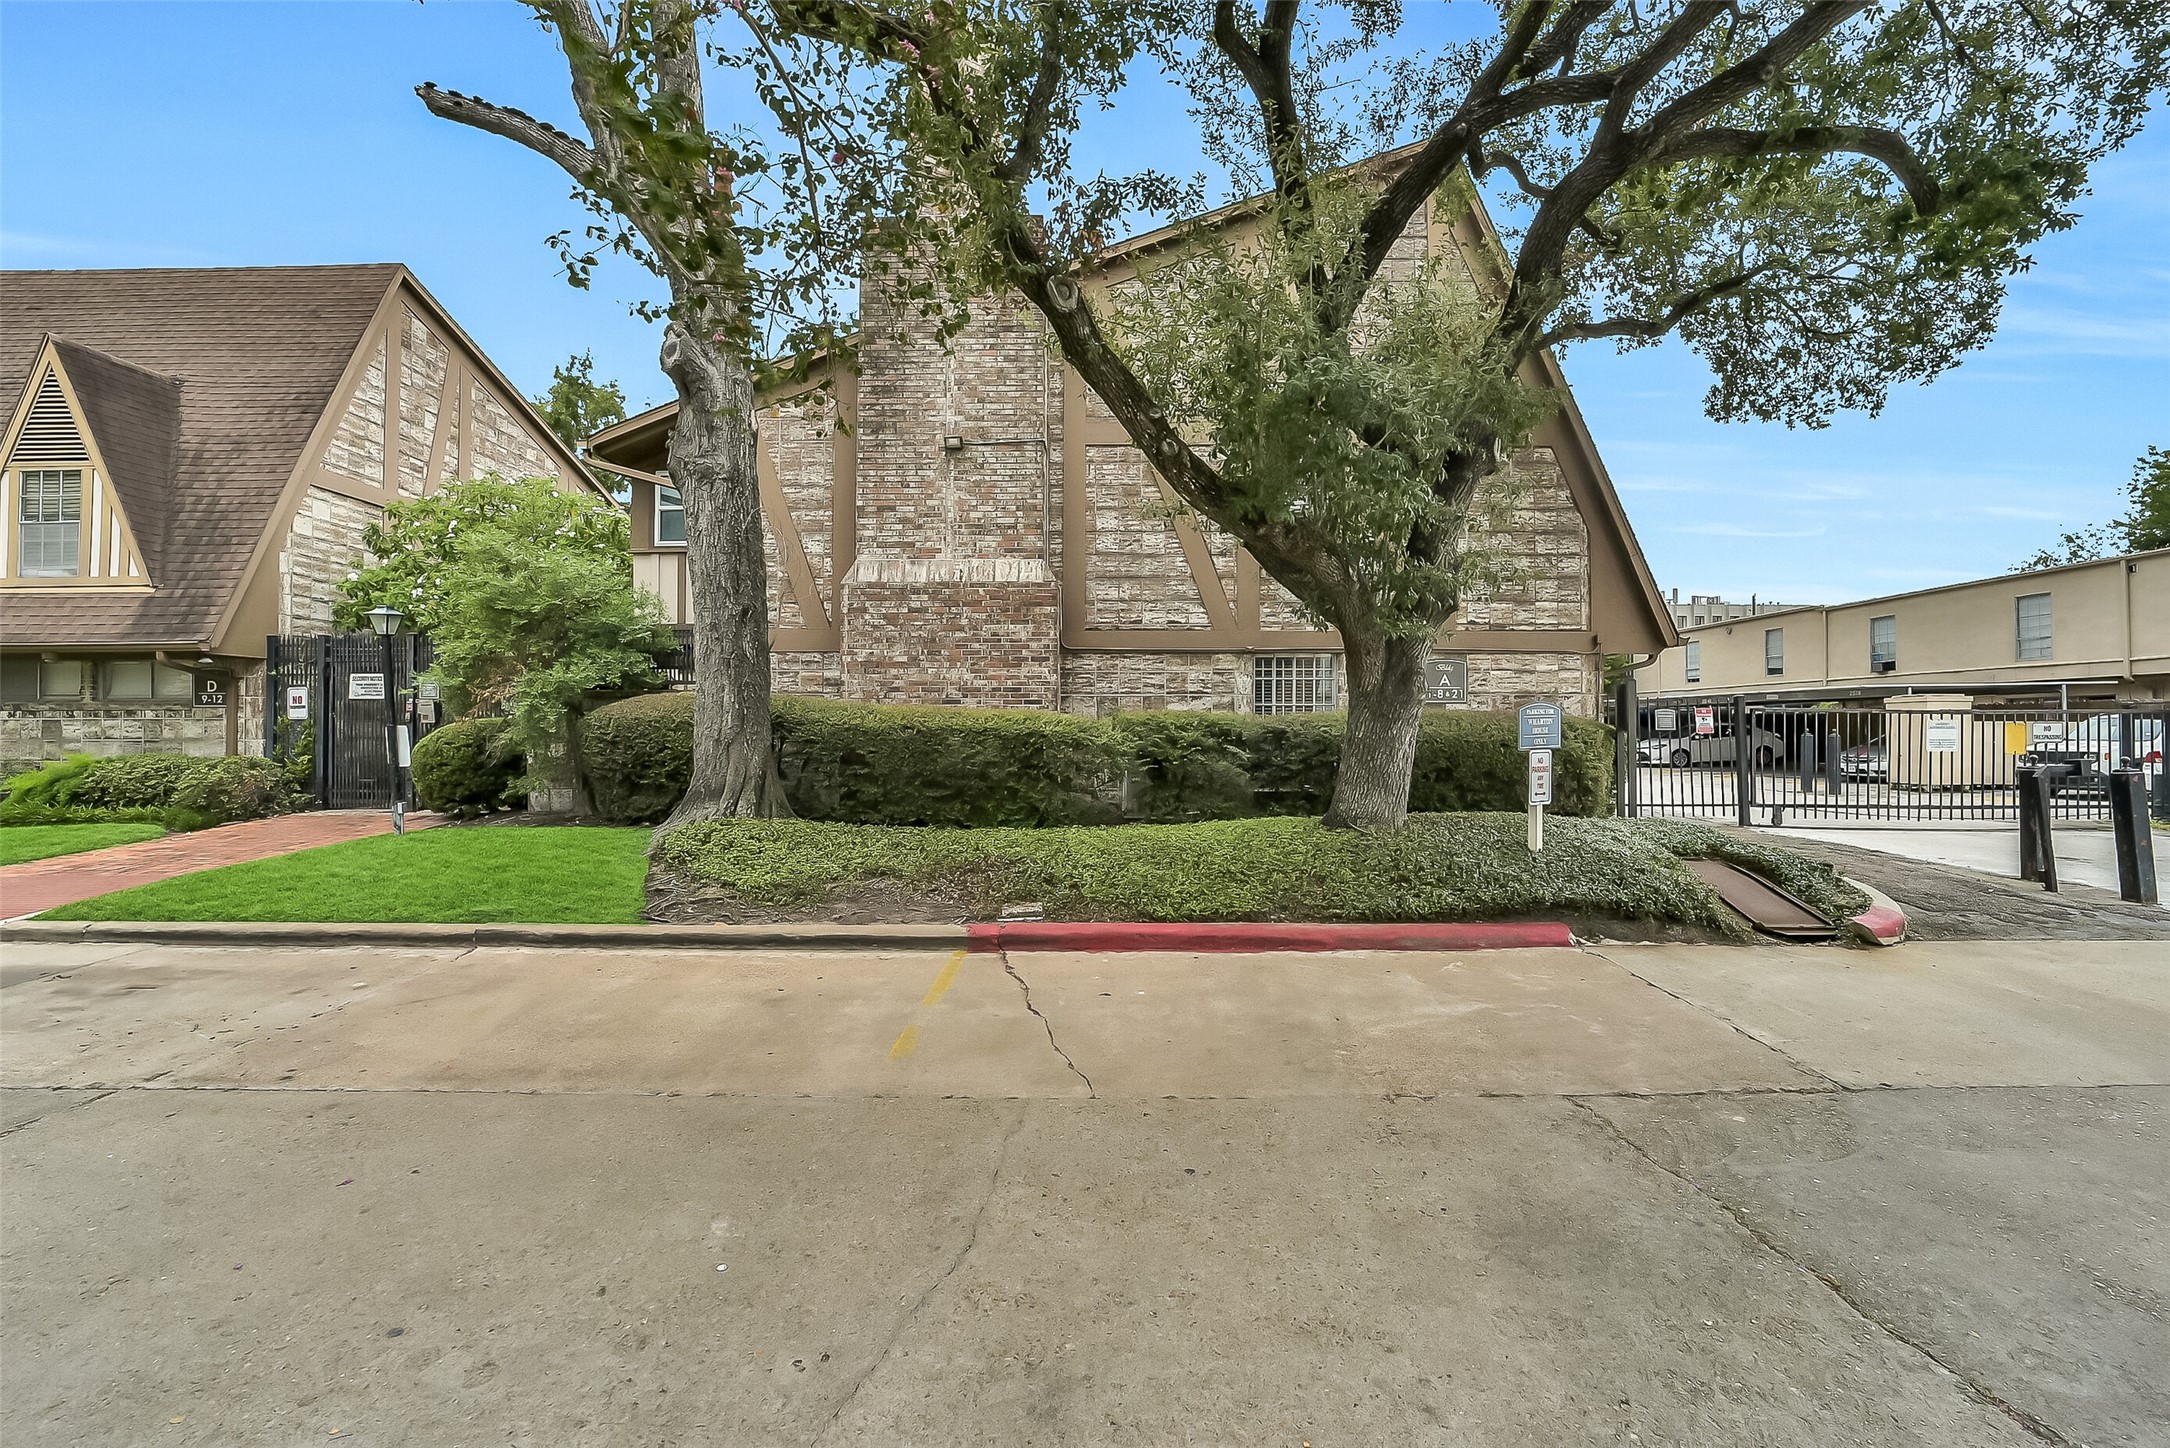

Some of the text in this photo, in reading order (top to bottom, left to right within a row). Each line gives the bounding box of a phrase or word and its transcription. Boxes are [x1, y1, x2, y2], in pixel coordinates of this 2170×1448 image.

[1439, 673, 1451, 687] A
[207, 680, 217, 693] D
[201, 694, 223, 704] 9-12
[292, 695, 303, 705] NO
[1537, 757, 1544, 765] NO
